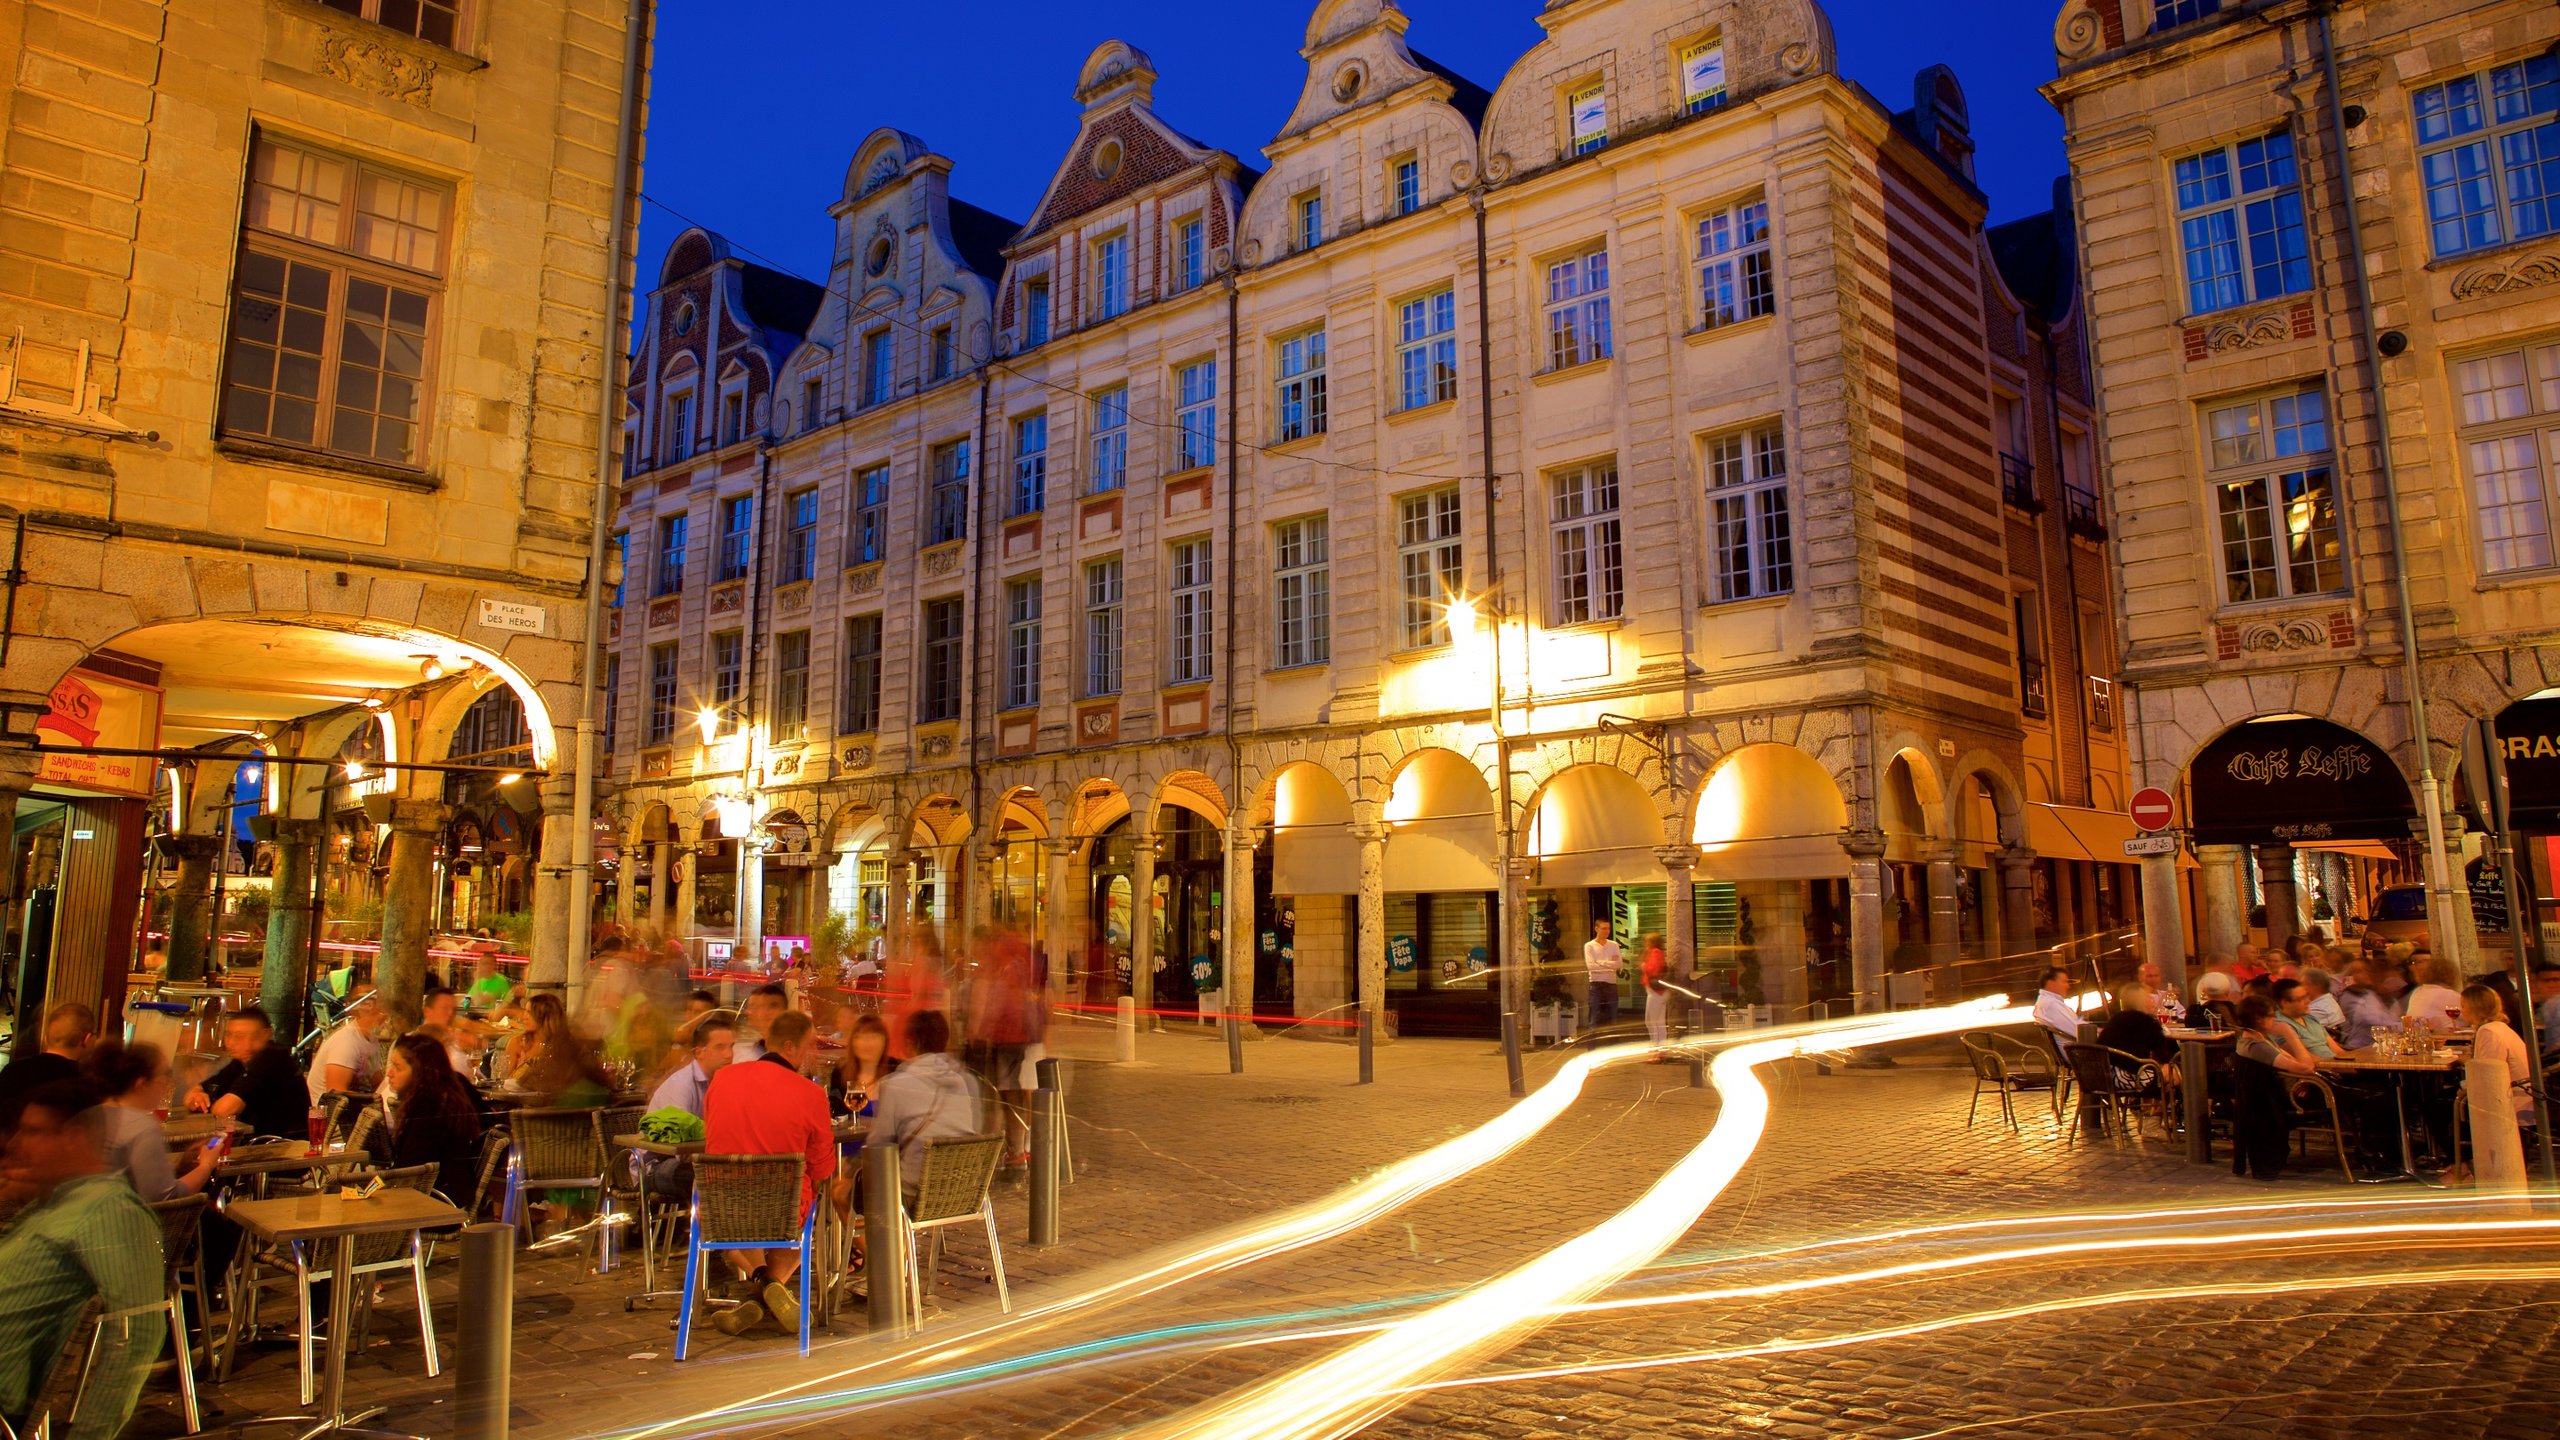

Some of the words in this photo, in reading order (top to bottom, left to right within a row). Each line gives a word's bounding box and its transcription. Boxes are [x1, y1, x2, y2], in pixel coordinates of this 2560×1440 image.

[1687, 51, 1691, 59] A
[1693, 38, 1721, 56] VENDRE
[502, 606, 525, 614] PLACE
[487, 615, 503, 624] DES
[509, 617, 536, 628] HÉROS
[2496, 736, 2560, 759] BRA
[51, 755, 96, 772] SANDWICHS
[108, 764, 131, 777] KEBAB
[2227, 748, 2289, 785] Café
[2296, 745, 2372, 781] Leffe
[2127, 843, 2148, 852] SAUF
[1391, 938, 1408, 948] Bonne
[1392, 946, 1411, 958] Fête
[1394, 956, 1412, 966] Papa
[1191, 962, 1212, 980] -50%
